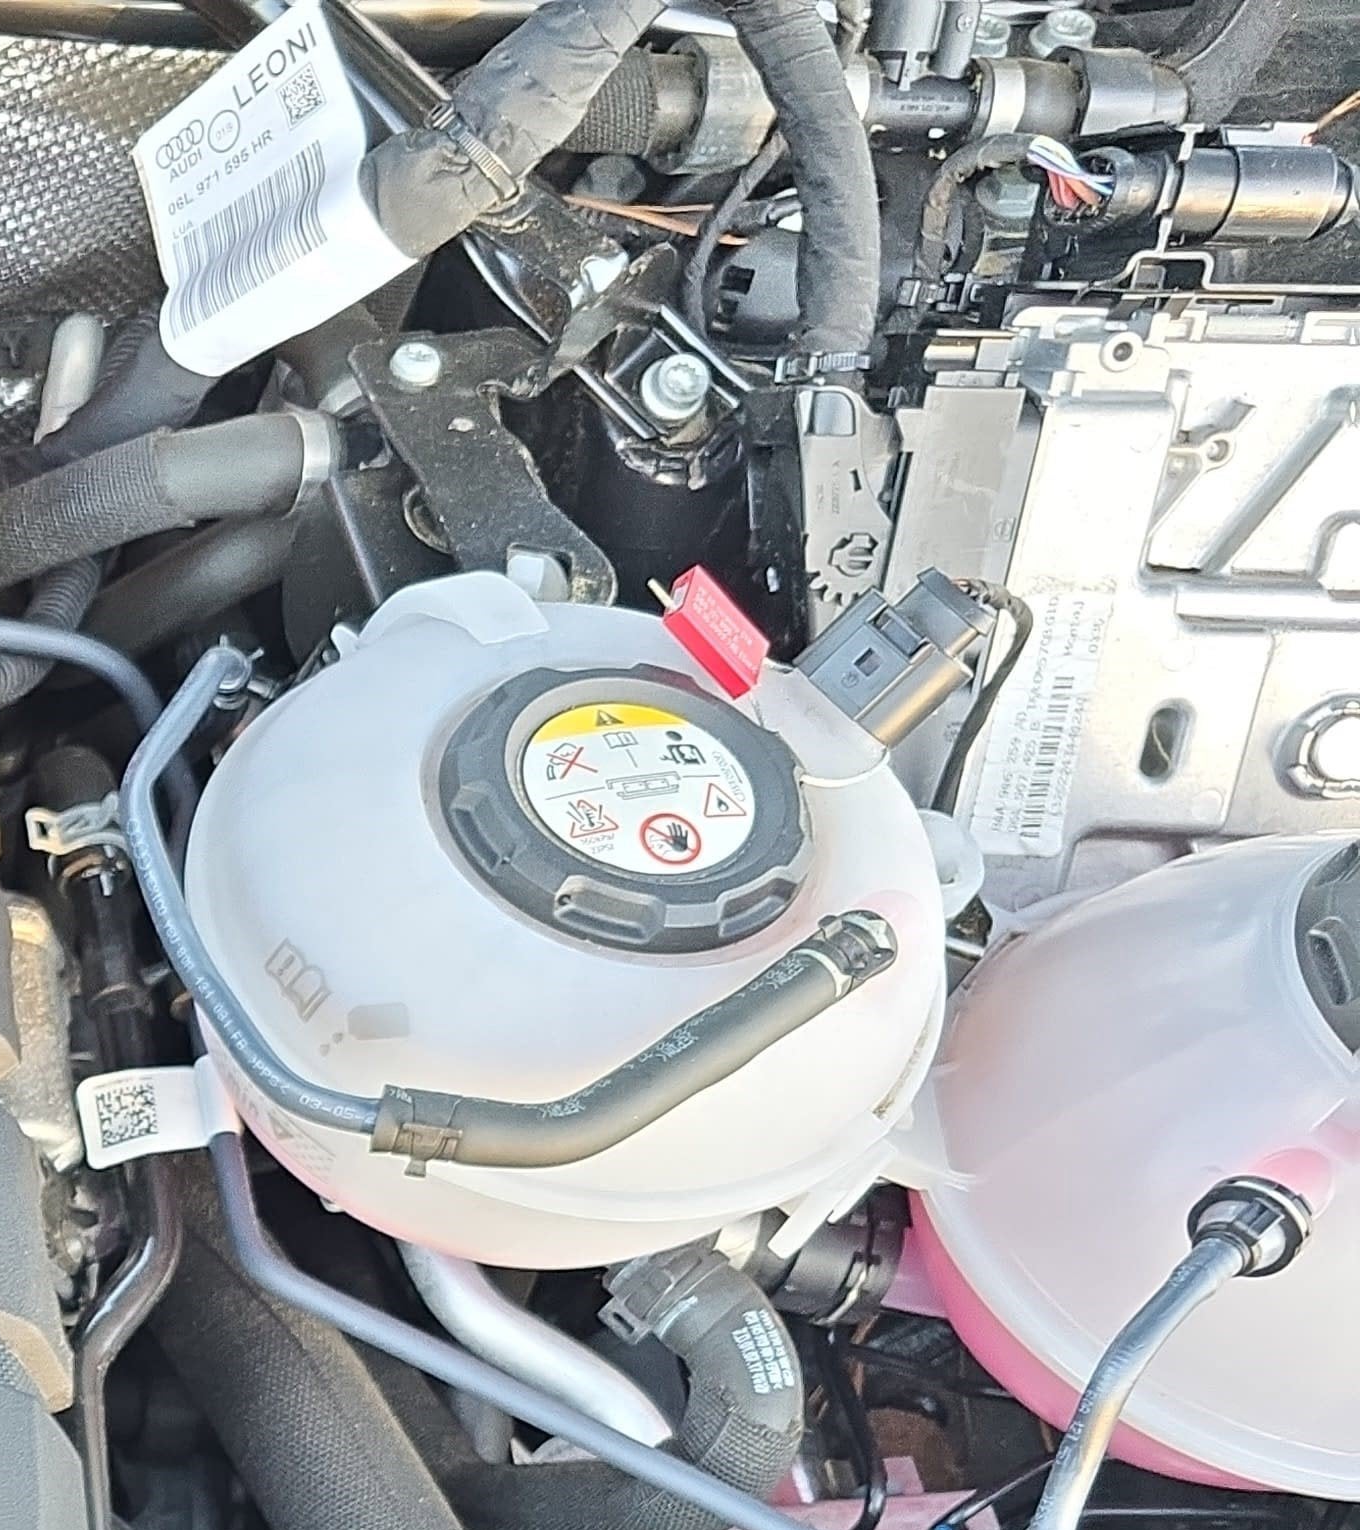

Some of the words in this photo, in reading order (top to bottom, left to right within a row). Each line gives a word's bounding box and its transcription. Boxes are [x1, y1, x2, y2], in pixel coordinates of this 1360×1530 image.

[232, 22, 317, 110] LEONI
[250, 129, 274, 155] HR
[169, 149, 202, 183] AUDI
